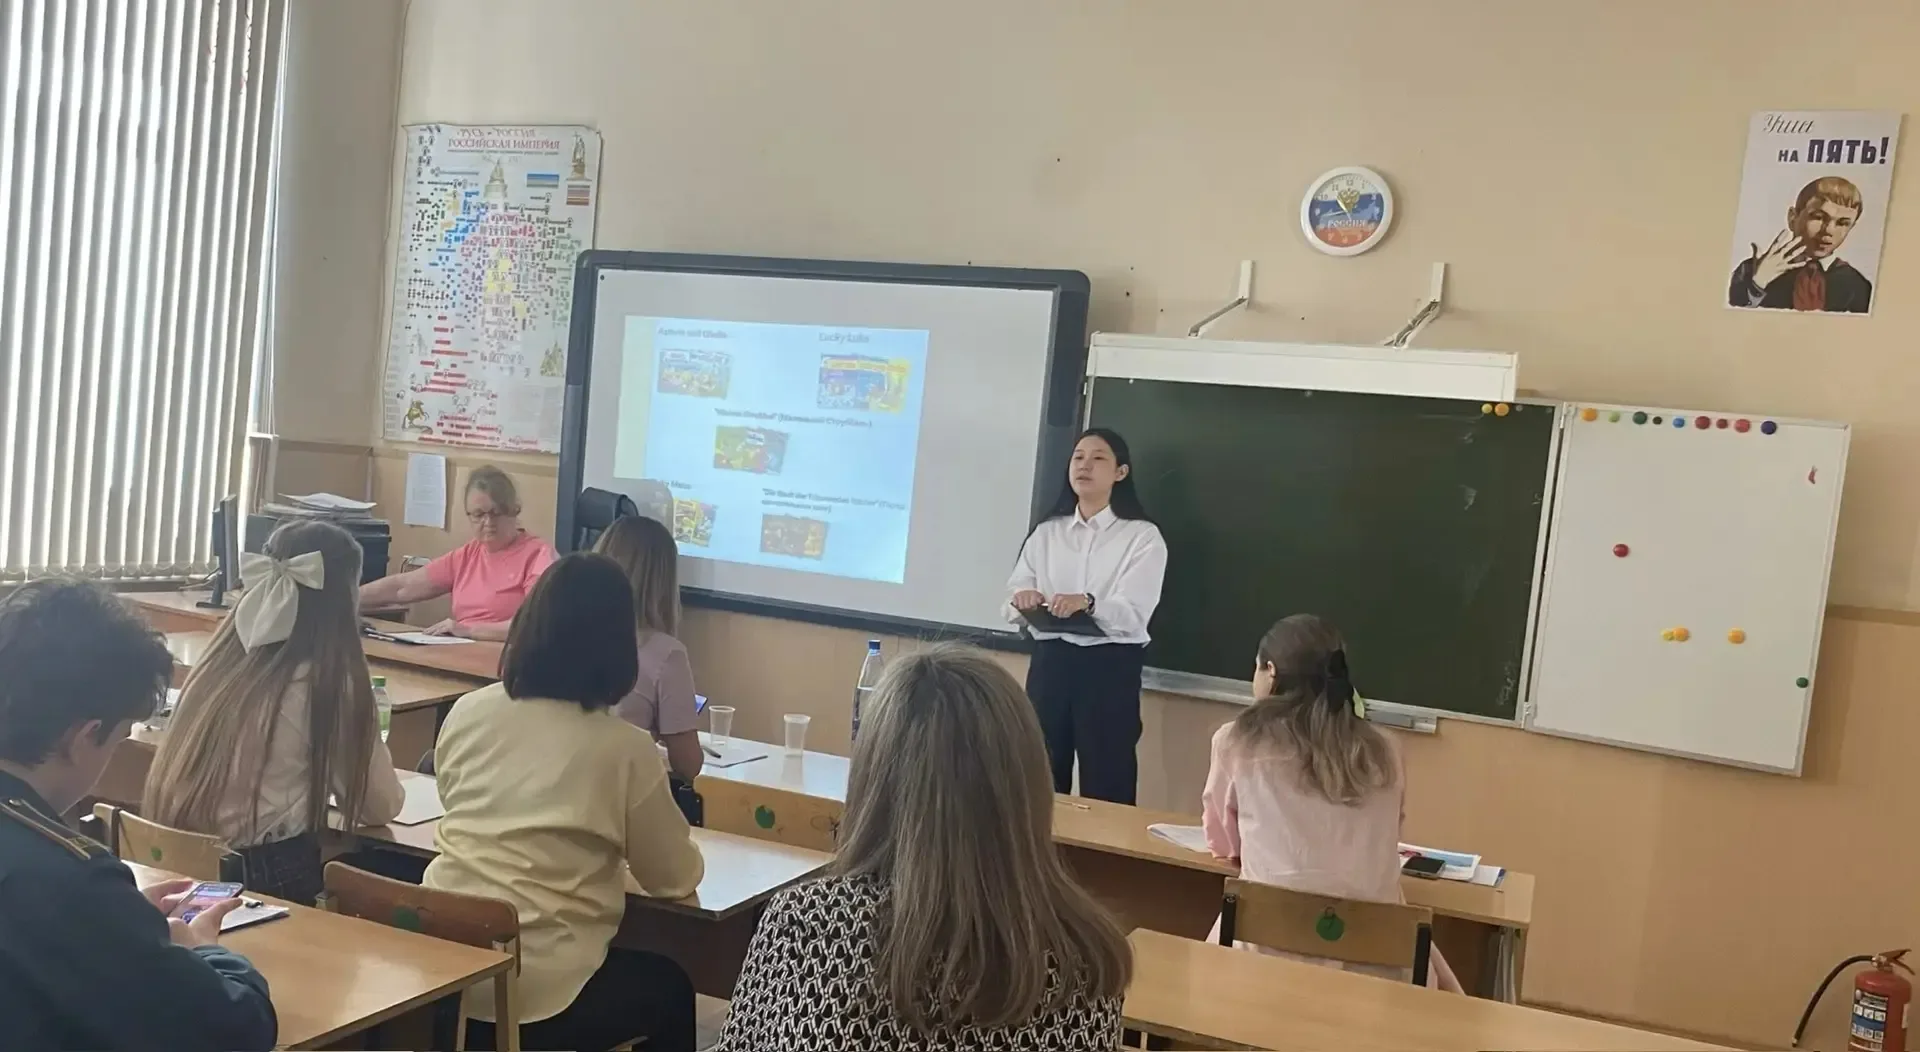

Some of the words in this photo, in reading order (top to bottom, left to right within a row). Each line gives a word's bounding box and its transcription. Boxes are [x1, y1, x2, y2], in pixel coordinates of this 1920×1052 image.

[492, 128, 537, 138] РОССИЯ
[448, 138, 510, 149] РОССИЙСКАЯ
[513, 139, 561, 149] ИМПЕРИЯ
[1778, 149, 1799, 163] НА
[1807, 137, 1889, 164] ПЯТЬ!
[1328, 220, 1366, 228] РОССИЯ
